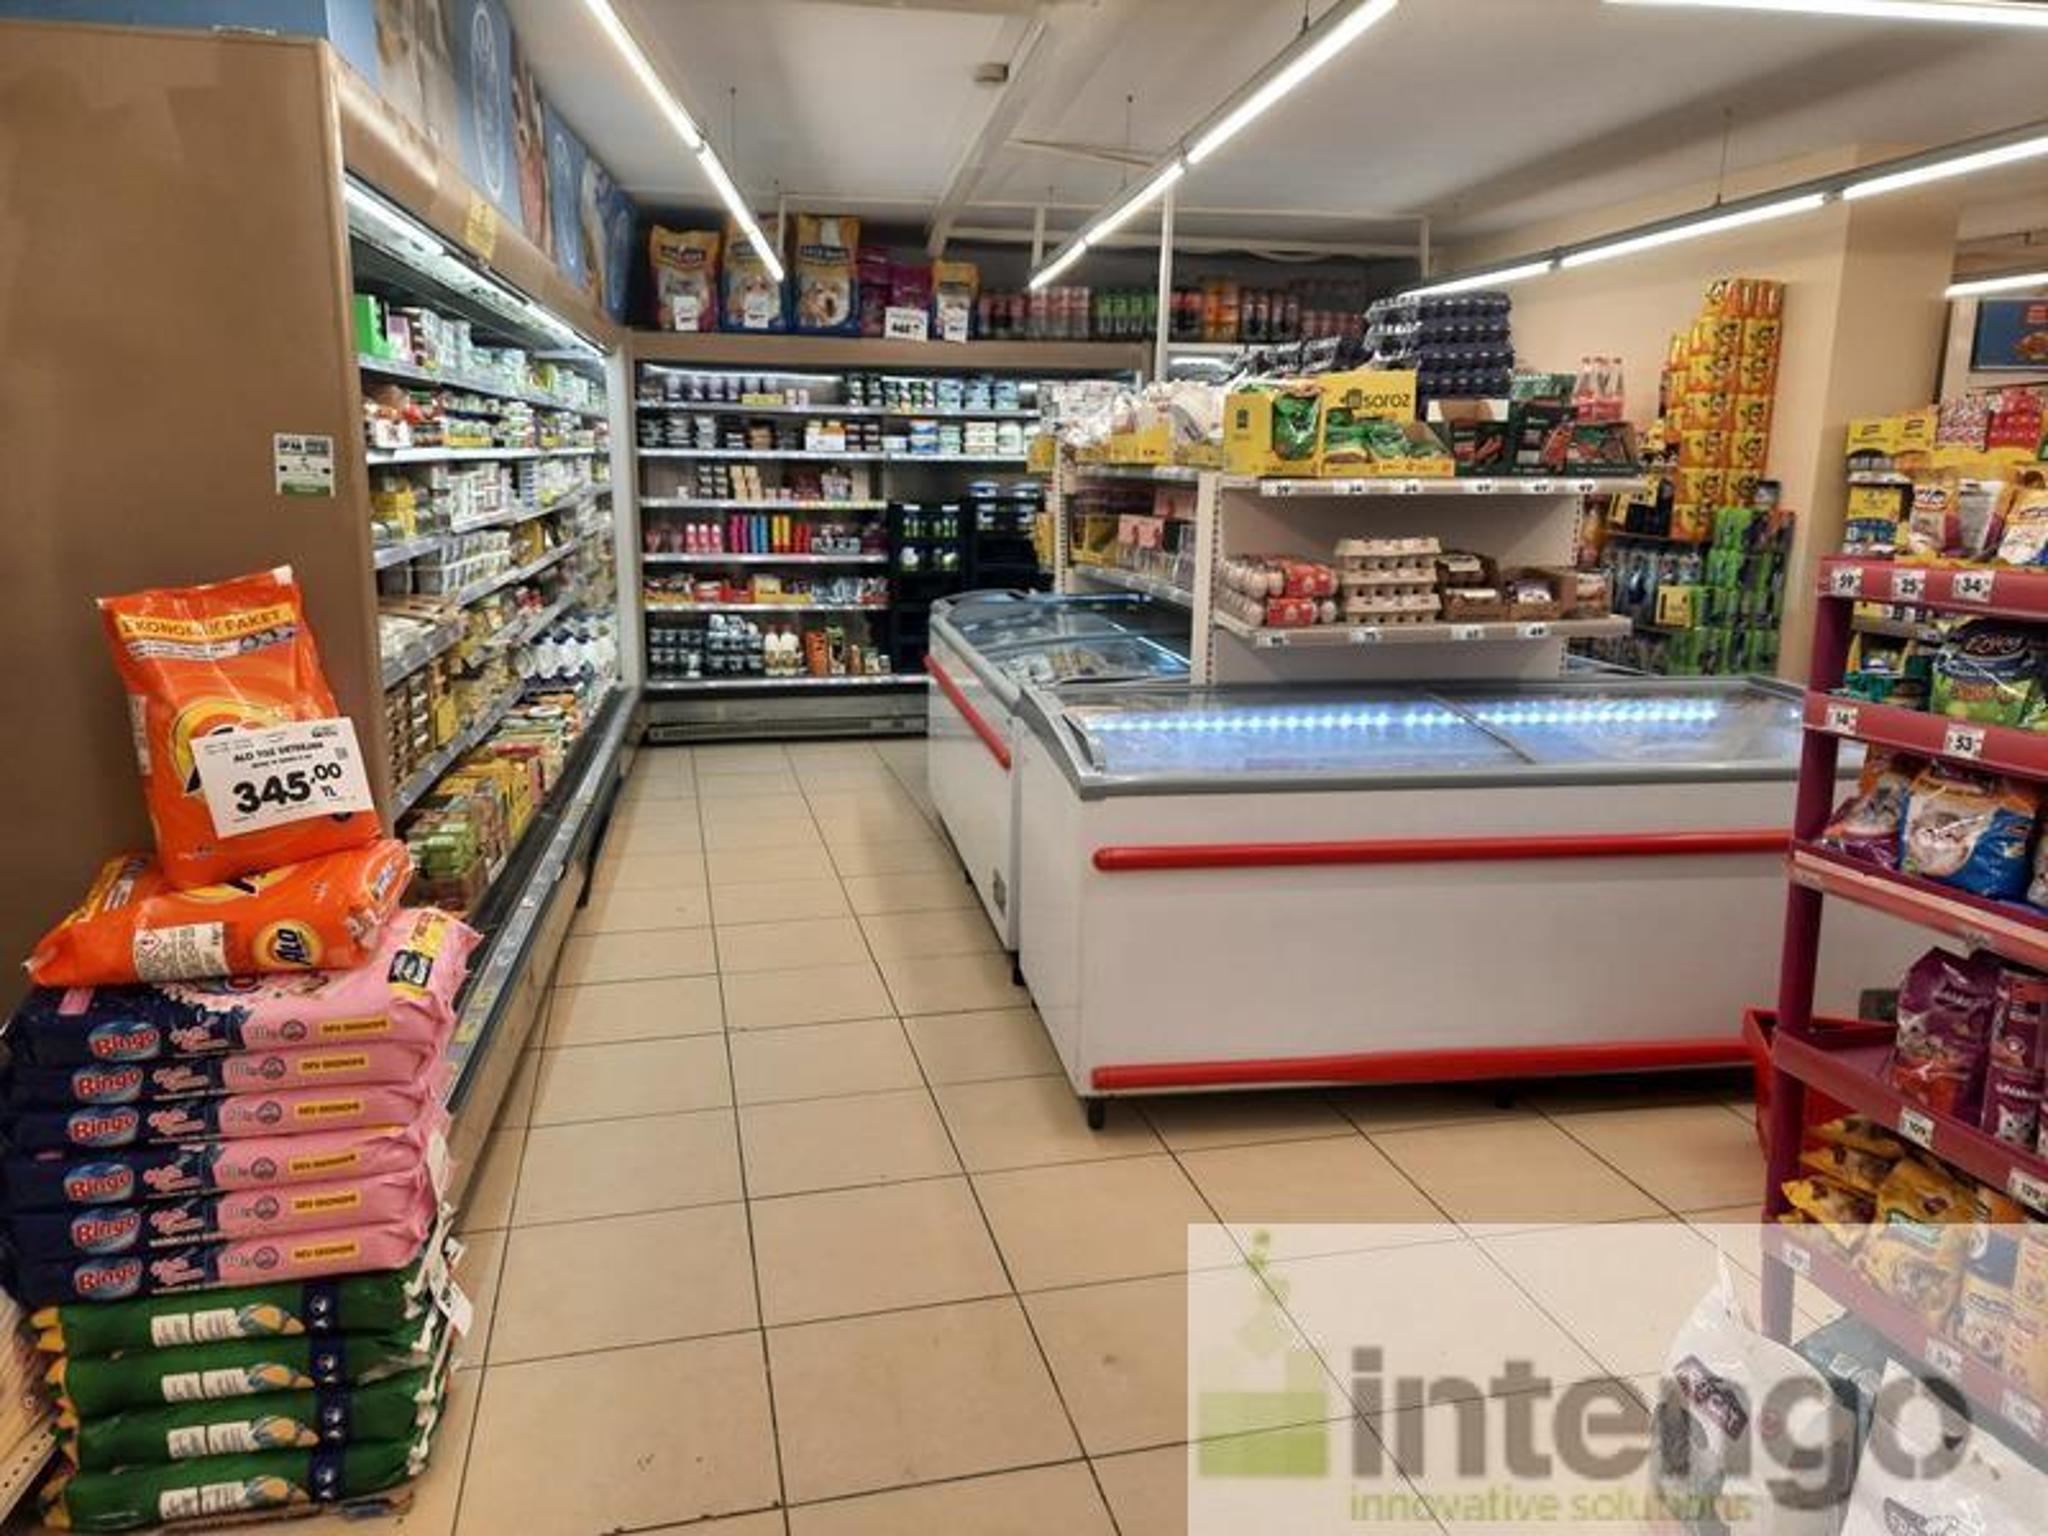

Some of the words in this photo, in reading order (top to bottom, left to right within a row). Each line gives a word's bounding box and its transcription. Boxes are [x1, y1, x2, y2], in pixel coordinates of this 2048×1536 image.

[1961, 576, 1982, 593] 34
[1955, 736, 1973, 751] 53
[320, 784, 337, 798] TL
[94, 1028, 158, 1055] Bingo
[78, 1069, 139, 1096] Bingo
[72, 1114, 135, 1139] Bingo
[69, 1170, 131, 1199] Bingo
[76, 1215, 136, 1244] Bingo
[78, 1262, 139, 1292] Bingo
